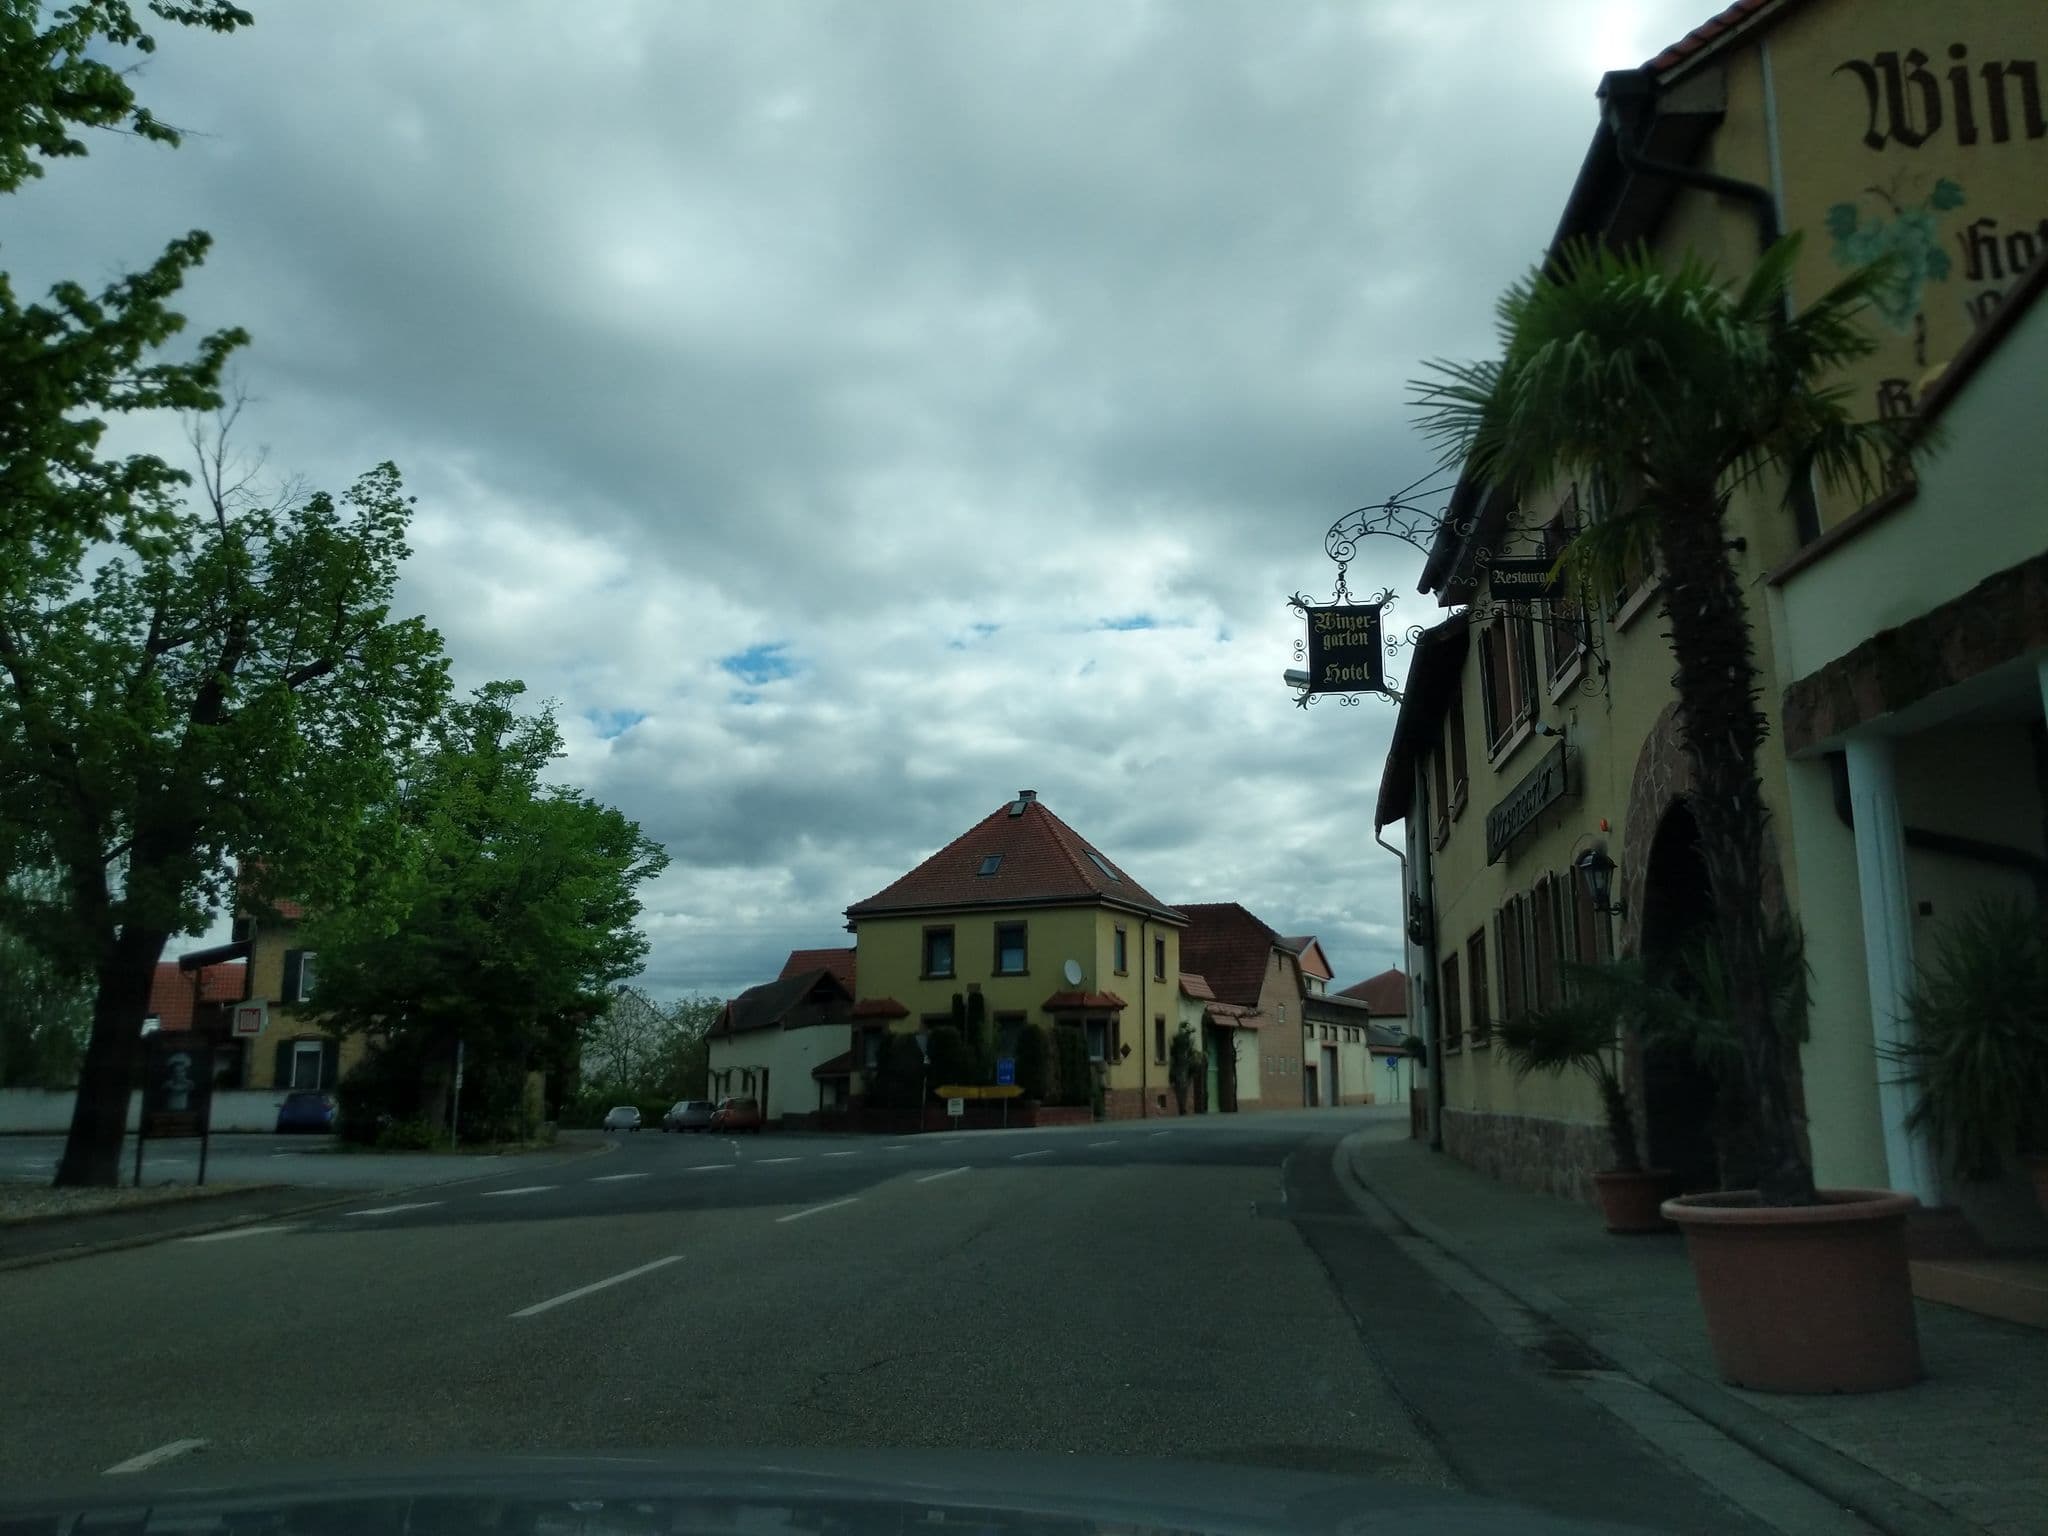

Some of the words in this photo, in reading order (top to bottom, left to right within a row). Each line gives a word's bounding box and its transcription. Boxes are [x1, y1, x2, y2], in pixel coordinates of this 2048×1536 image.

[1312, 611, 1377, 632] Winzer-
[1322, 630, 1369, 651] garten
[1323, 661, 1370, 684] Hotel
